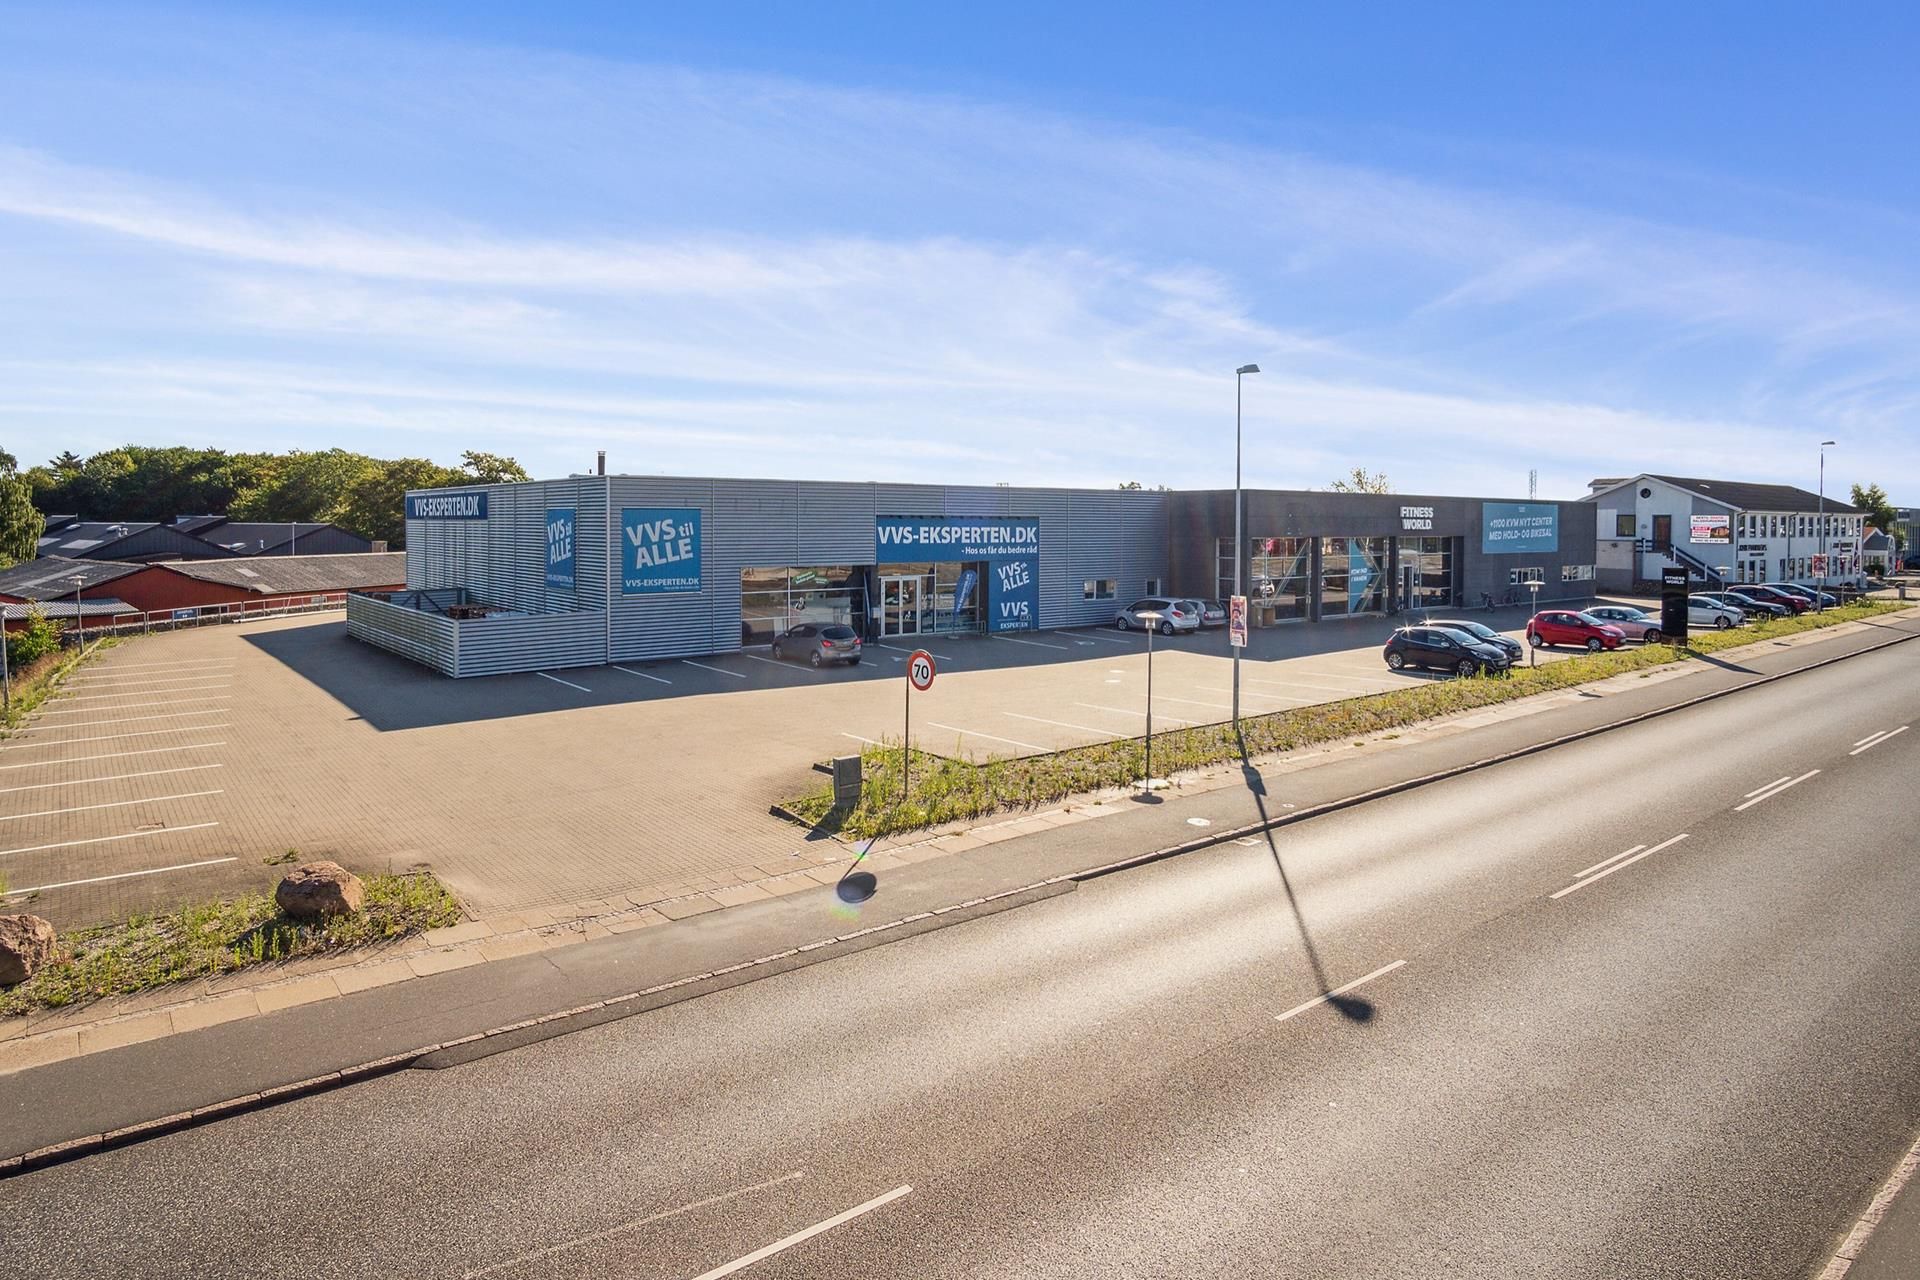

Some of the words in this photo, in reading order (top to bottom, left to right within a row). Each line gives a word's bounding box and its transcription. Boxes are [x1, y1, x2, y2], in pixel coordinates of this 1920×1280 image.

[414, 496, 479, 516] VVS-EKSPERTEN.DK
[1400, 506, 1434, 518] FITNESS
[1402, 518, 1432, 530] WORLD
[1519, 517, 1531, 527] NYT
[1531, 516, 1553, 526] CENTER
[547, 519, 565, 543] VVS
[626, 519, 676, 546] VVS
[678, 522, 694, 537] til
[877, 526, 1037, 544] VVS-EKSPERTEN.DK
[1488, 531, 1502, 540] MED
[550, 537, 572, 565] ALLE
[636, 538, 694, 569] ALLE
[965, 546, 978, 554] Hos
[1007, 545, 1026, 553] bedre
[998, 562, 1020, 579] VVS
[625, 577, 699, 587] VVS-EKSPERTEN.DK
[1003, 571, 1030, 592] ALLE
[1001, 601, 1028, 617] VVS
[914, 664, 929, 680] 70
